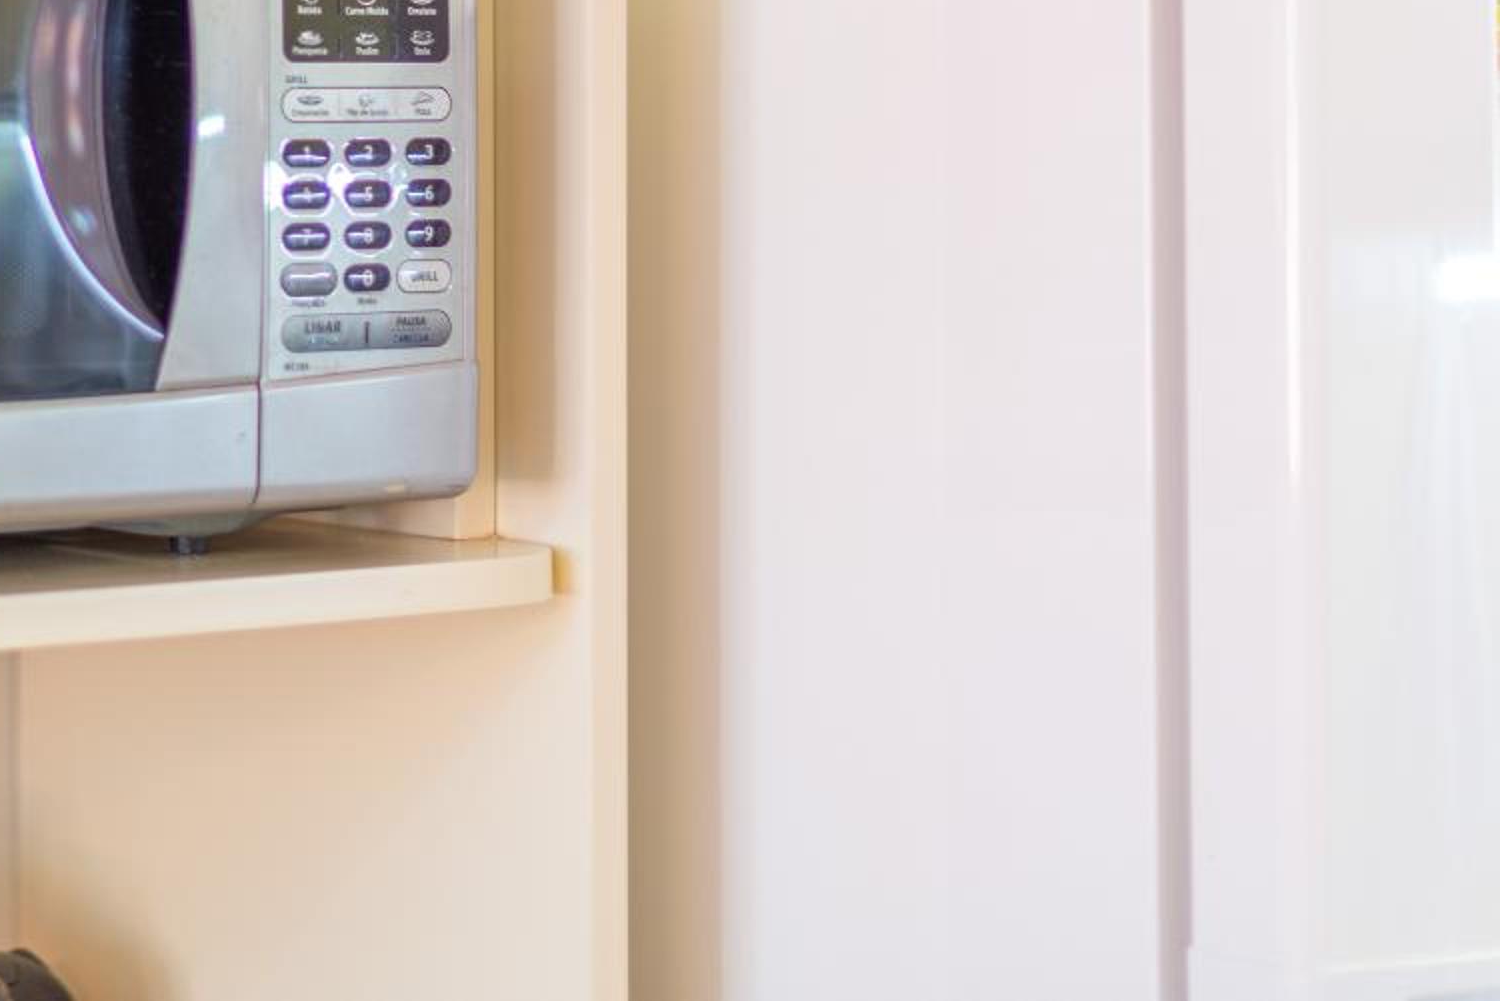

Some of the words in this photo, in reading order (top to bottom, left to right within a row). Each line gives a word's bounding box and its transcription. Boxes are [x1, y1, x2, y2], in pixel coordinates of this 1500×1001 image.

[364, 146, 373, 160] 2
[425, 145, 434, 159] 3
[364, 187, 373, 201] 5
[425, 186, 434, 200] 6
[364, 228, 373, 242] 8
[425, 226, 433, 241] 9
[363, 270, 374, 286] 0
